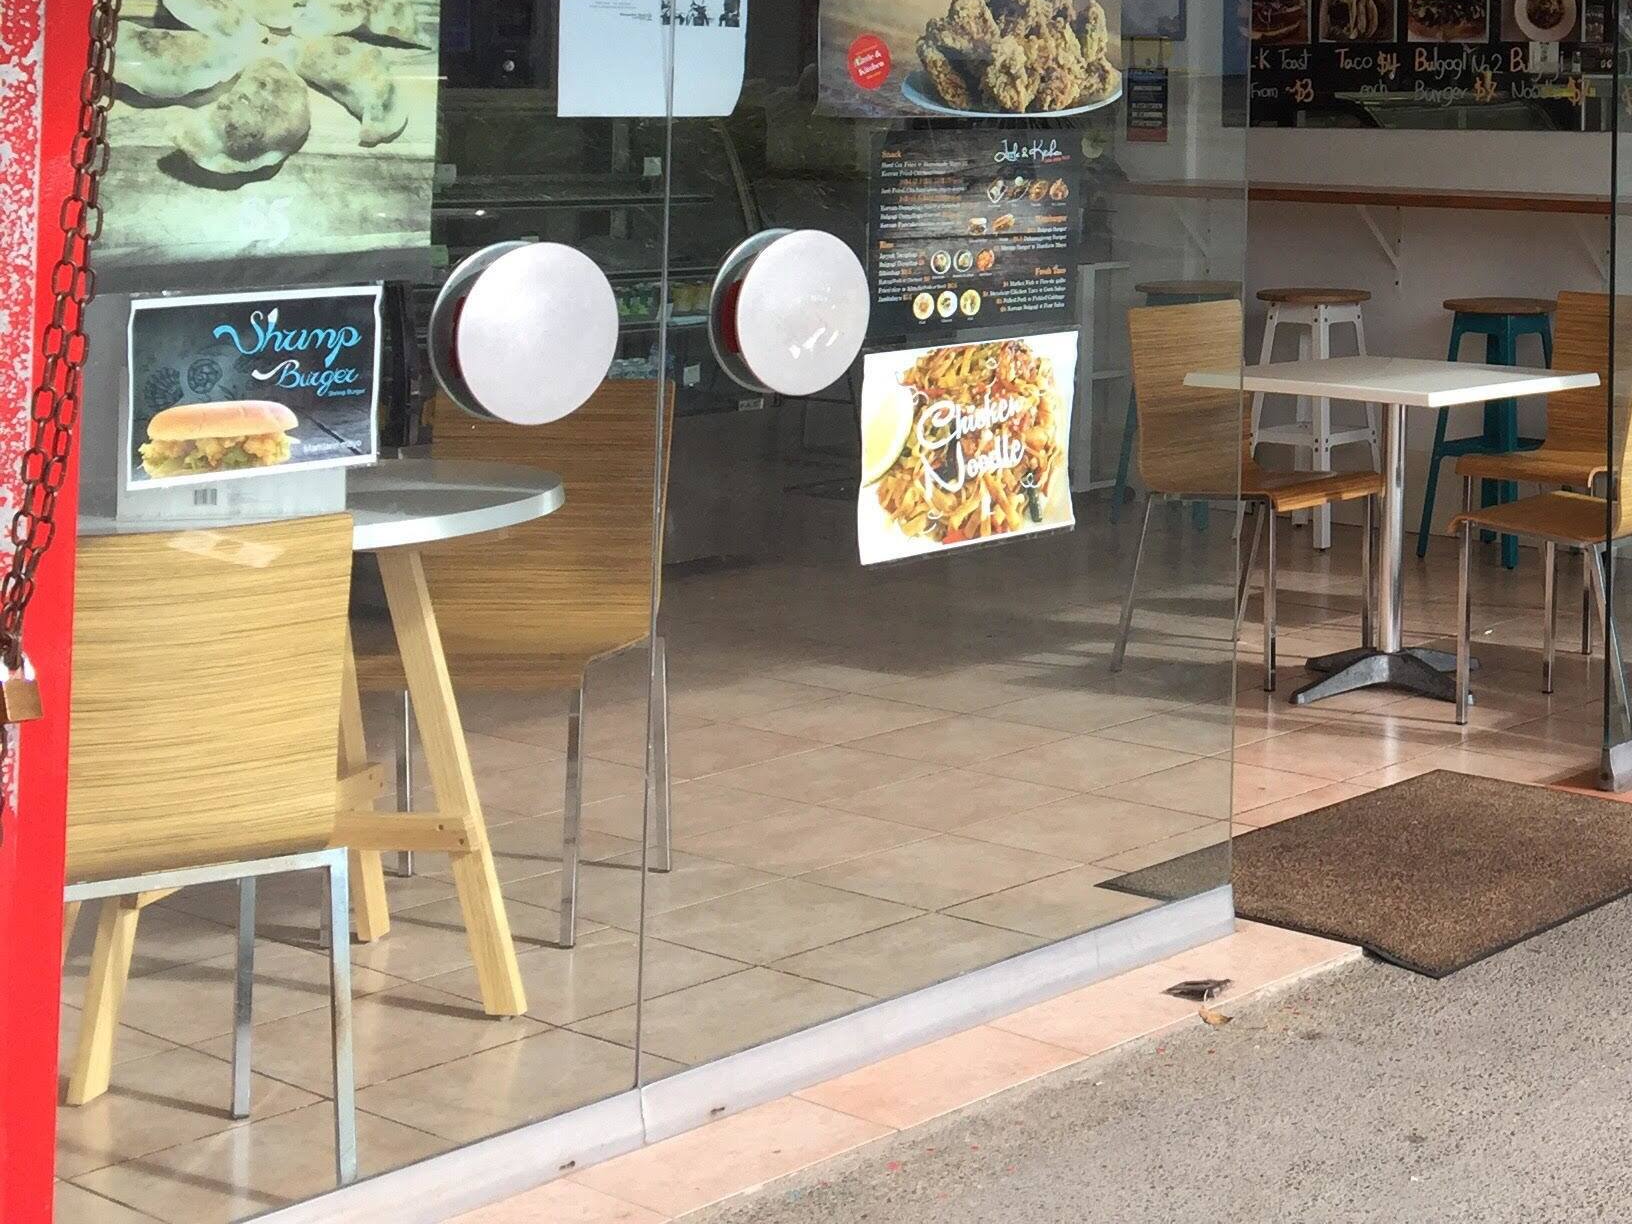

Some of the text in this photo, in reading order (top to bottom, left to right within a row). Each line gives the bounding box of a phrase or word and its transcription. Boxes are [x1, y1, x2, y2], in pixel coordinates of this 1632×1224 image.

[1277, 48, 1312, 70] Toast
[1334, 47, 1373, 70] Taco
[1415, 46, 1467, 80] Bulgogi
[251, 359, 360, 398] Burger
[915, 391, 1025, 451] Chicken
[920, 434, 1026, 500] Noodle
